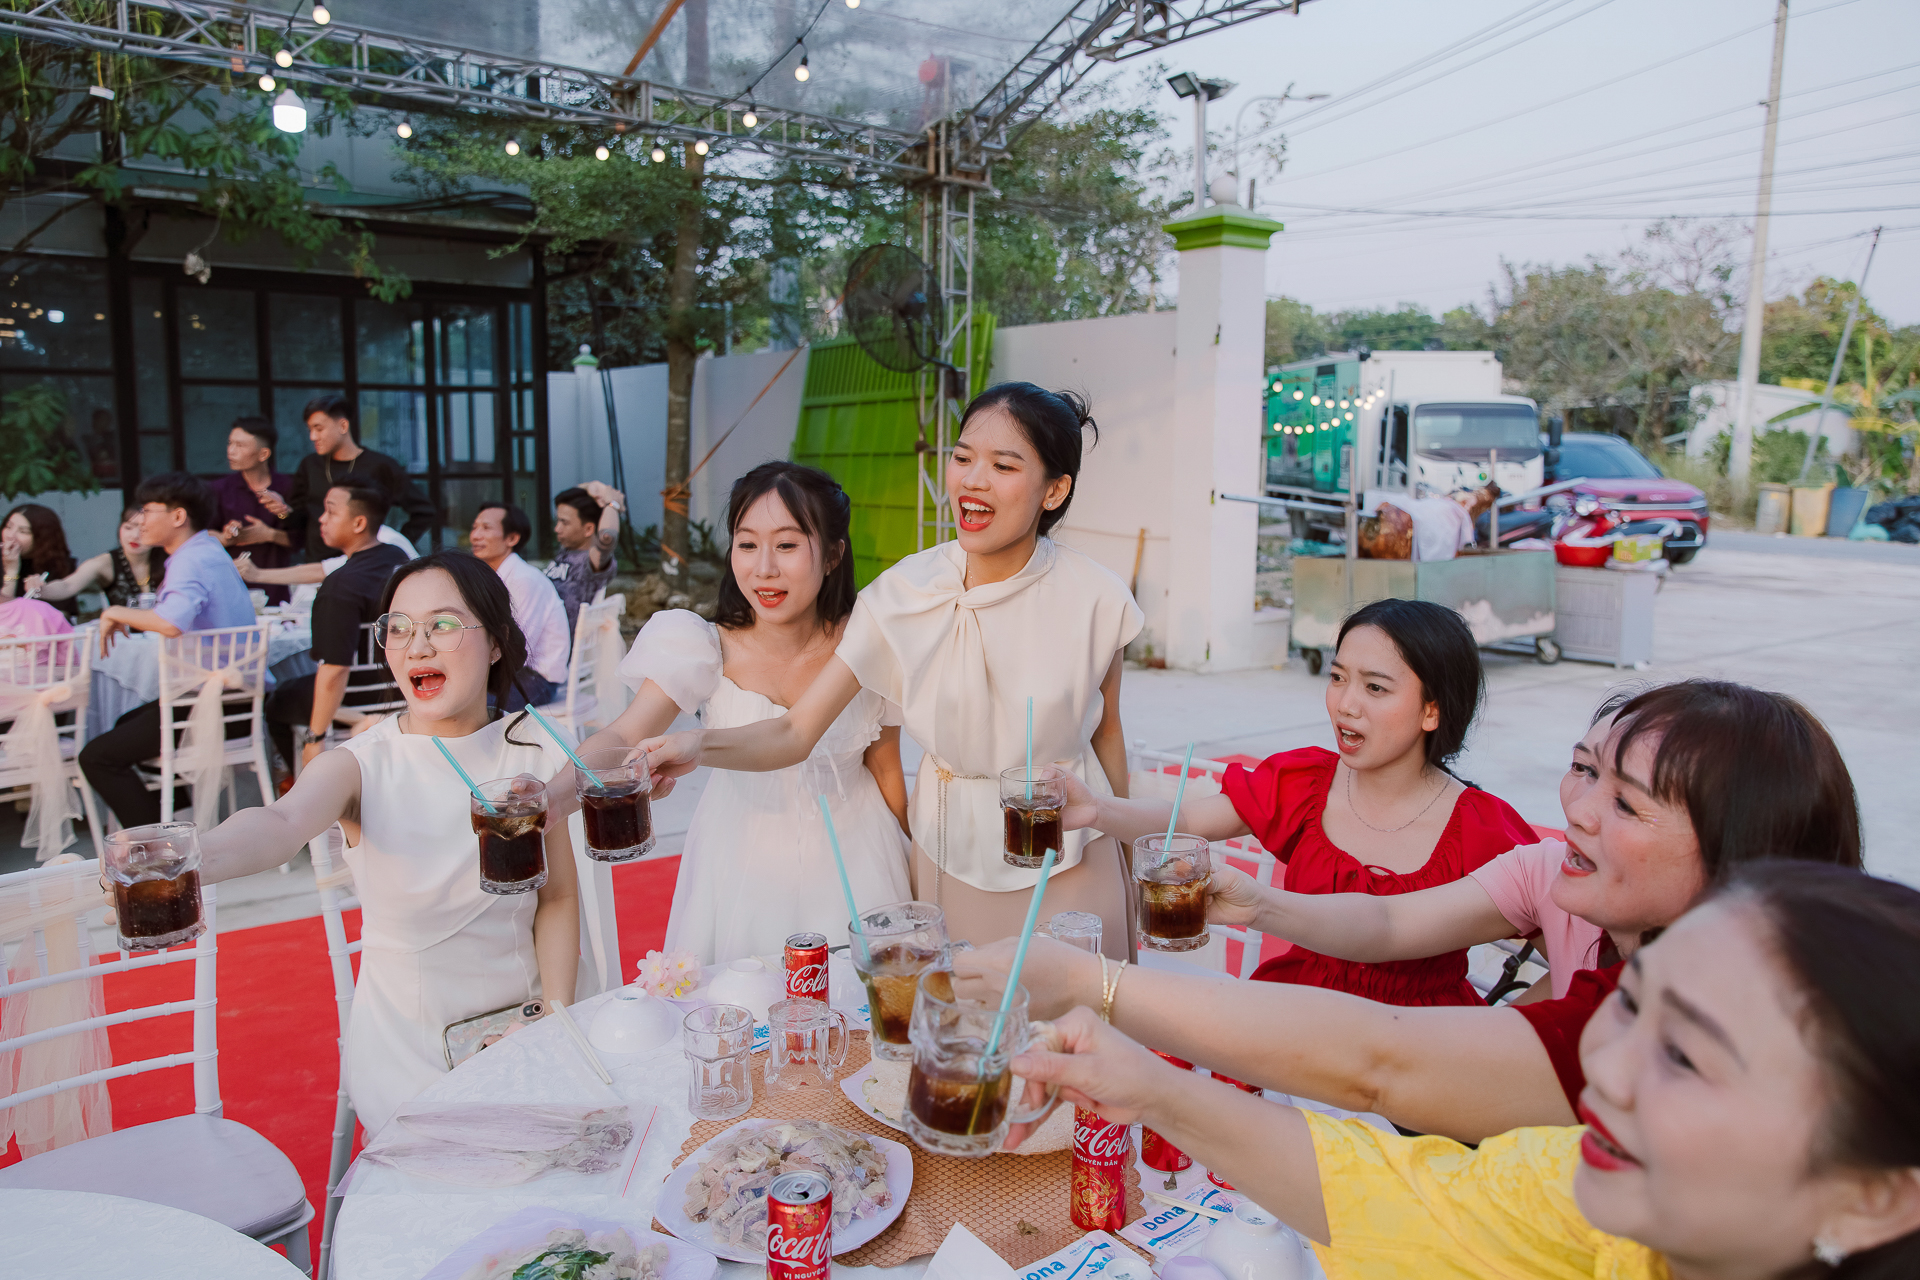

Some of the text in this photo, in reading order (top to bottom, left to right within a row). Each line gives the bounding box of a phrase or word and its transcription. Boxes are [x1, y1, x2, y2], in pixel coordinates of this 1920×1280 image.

[1076, 1153, 1102, 1166] NGUYÊN
[1142, 1206, 1187, 1231] Dona
[794, 1266, 825, 1279] NGUYÊN
[1020, 1261, 1067, 1280] ona
